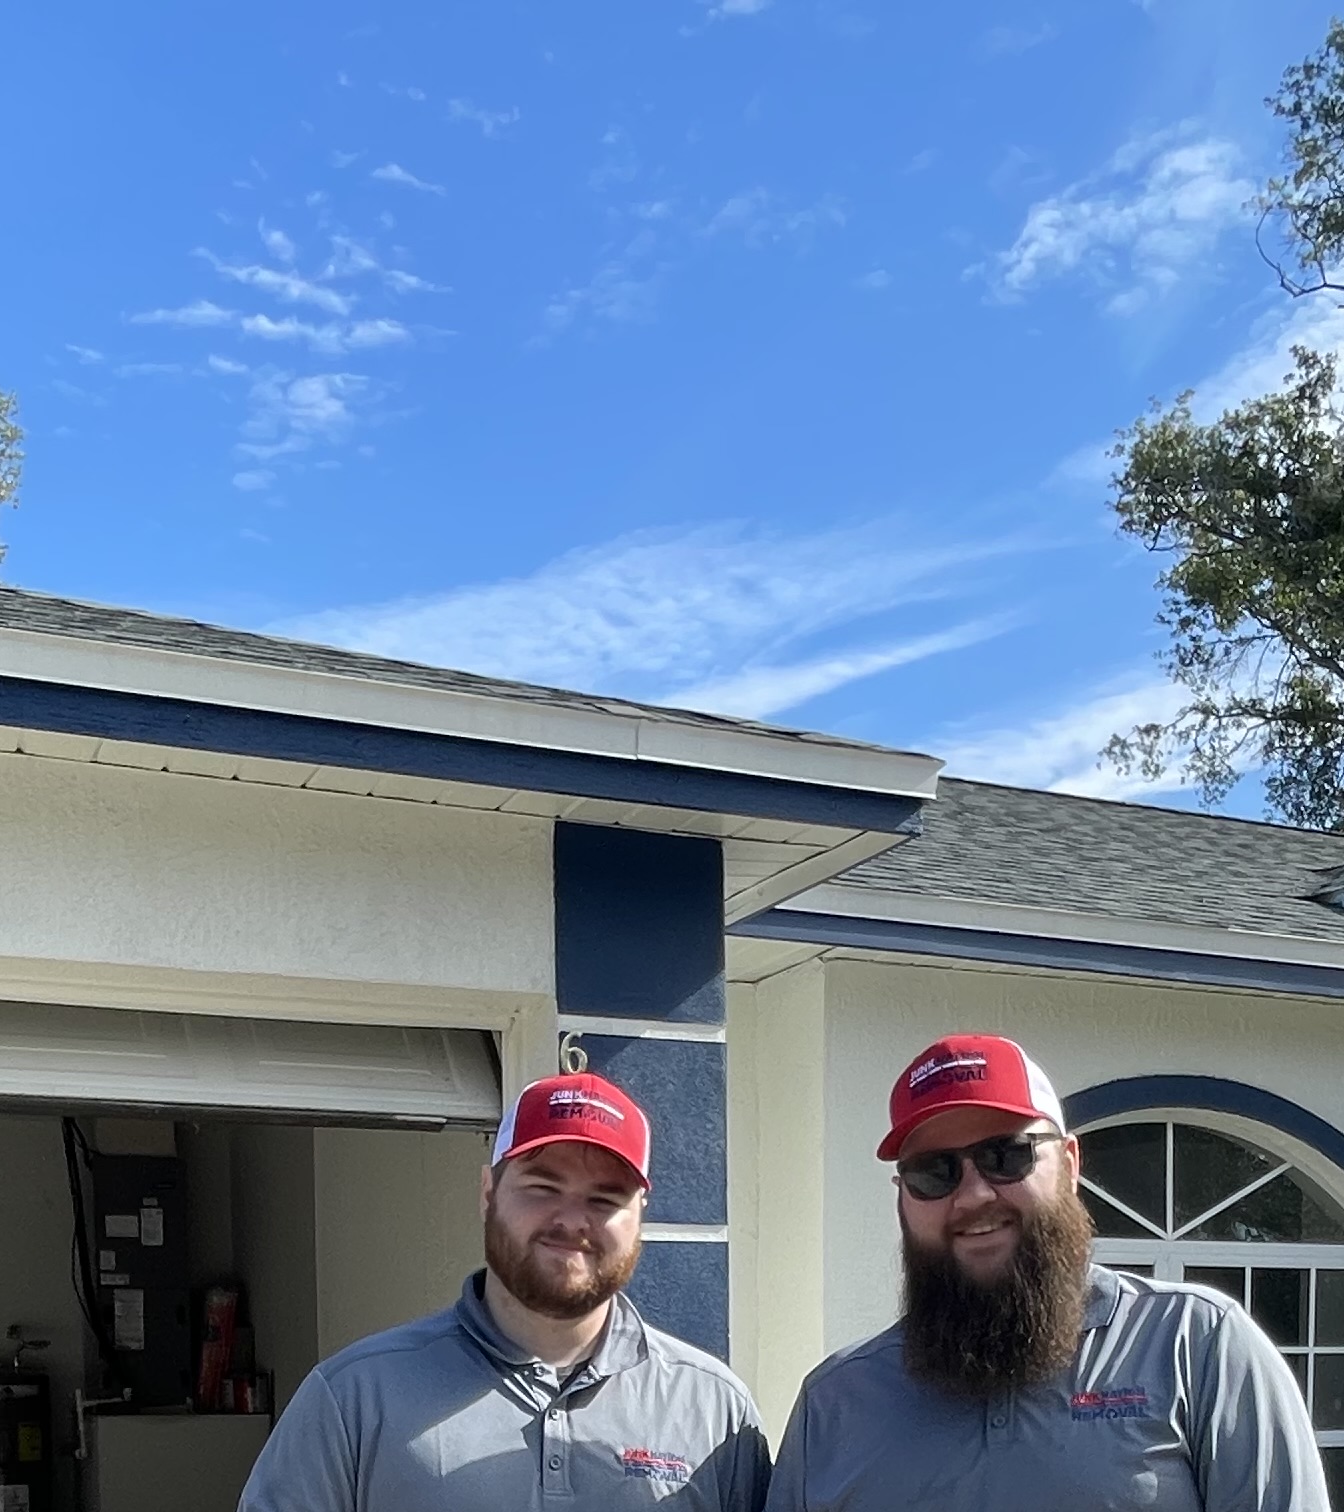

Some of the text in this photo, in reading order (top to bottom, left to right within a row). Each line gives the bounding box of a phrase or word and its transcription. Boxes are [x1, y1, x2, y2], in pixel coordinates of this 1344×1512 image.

[561, 1032, 588, 1074] 6
[909, 1058, 935, 1082] JUNK
[549, 1090, 583, 1100] JUNK
[549, 1106, 621, 1130] REMOV
